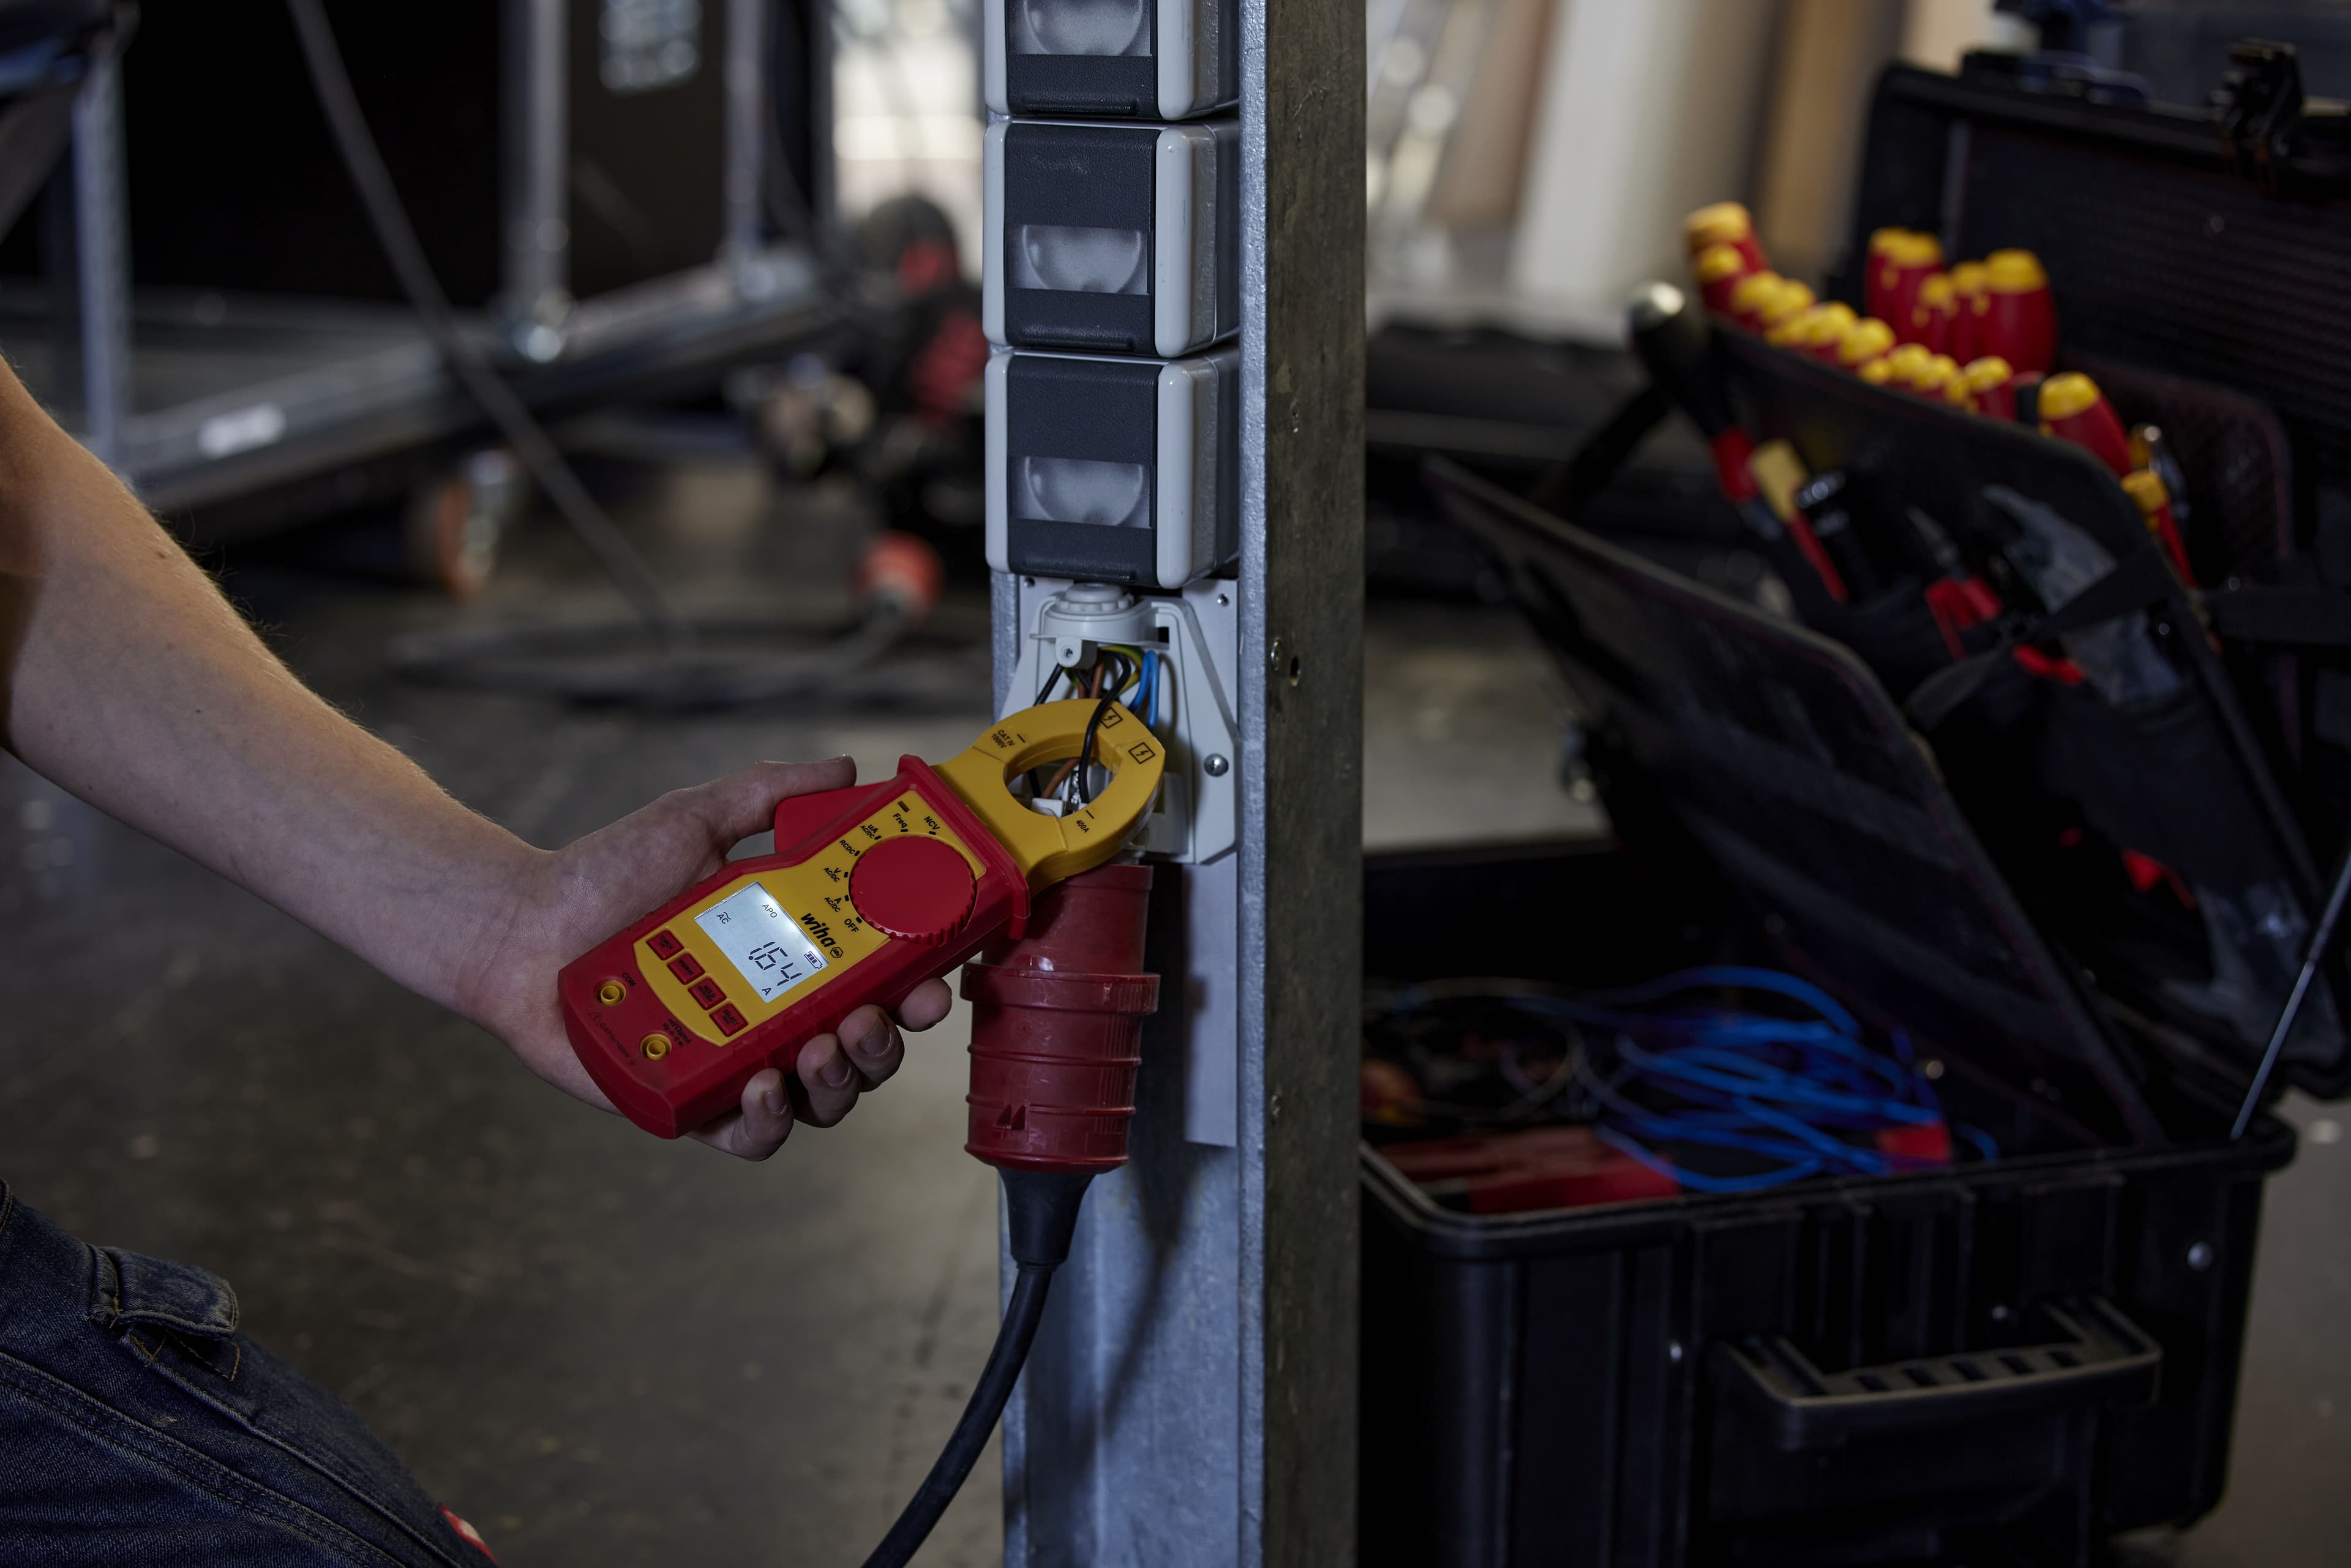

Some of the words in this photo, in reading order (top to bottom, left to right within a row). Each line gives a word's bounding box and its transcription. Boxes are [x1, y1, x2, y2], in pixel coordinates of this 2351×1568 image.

[991, 734, 1007, 748] 1000V
[998, 729, 1010, 740] CAT
[893, 812, 908, 828] Freq
[924, 816, 940, 830] NCV
[1076, 820, 1089, 833] 400A
[860, 825, 875, 838] AC/DC
[823, 867, 840, 882] AC/DC
[762, 904, 778, 918] APO
[824, 897, 841, 912] AC/DC
[717, 913, 729, 924] AC
[844, 918, 859, 932] OFF
[800, 913, 836, 947] wiha
[748, 942, 803, 986] 1.64
[622, 972, 637, 986] COM
